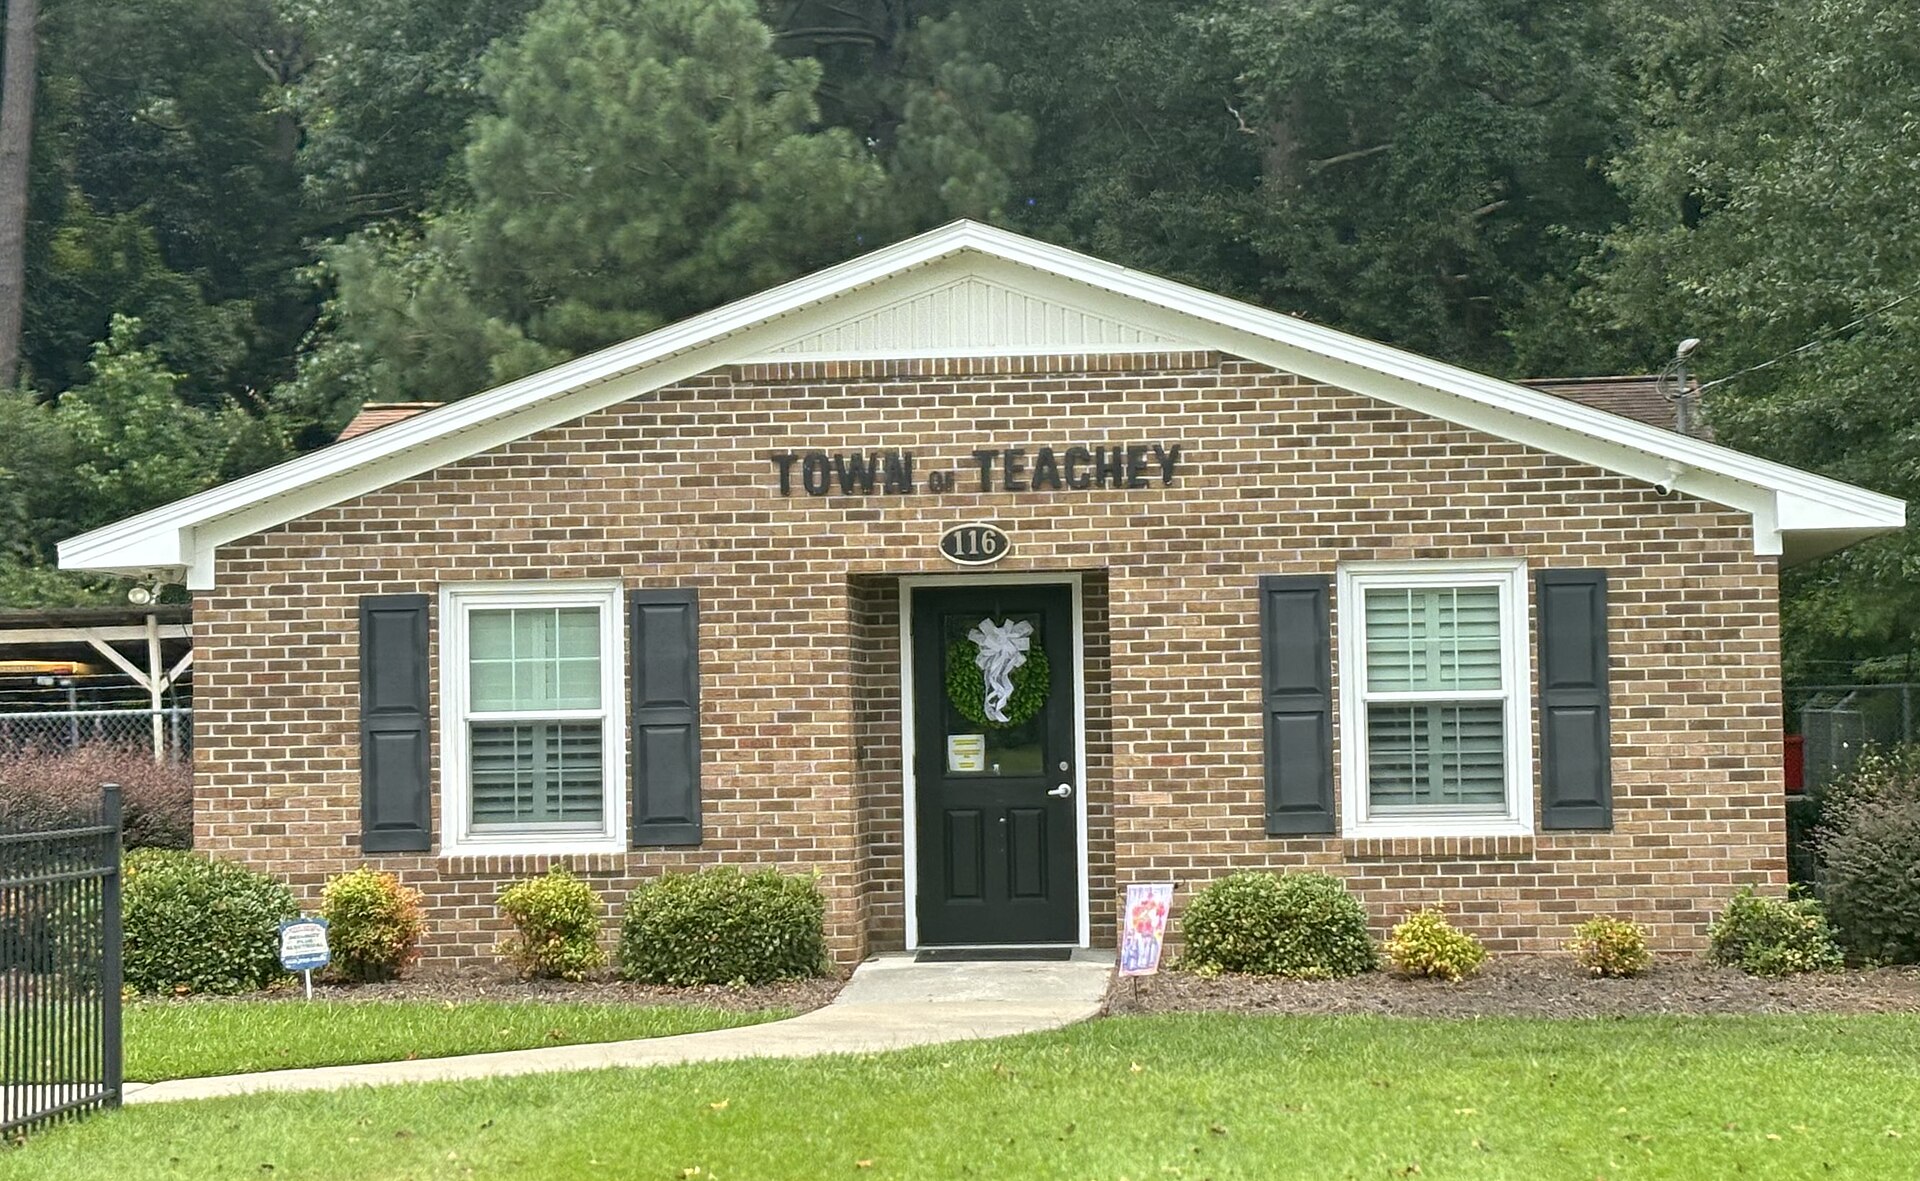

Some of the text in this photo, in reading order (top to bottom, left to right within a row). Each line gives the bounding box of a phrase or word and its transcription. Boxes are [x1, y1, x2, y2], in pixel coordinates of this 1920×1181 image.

[772, 451, 913, 497] TOWN
[972, 444, 1182, 493] TEACHEY
[953, 530, 997, 556] 116
